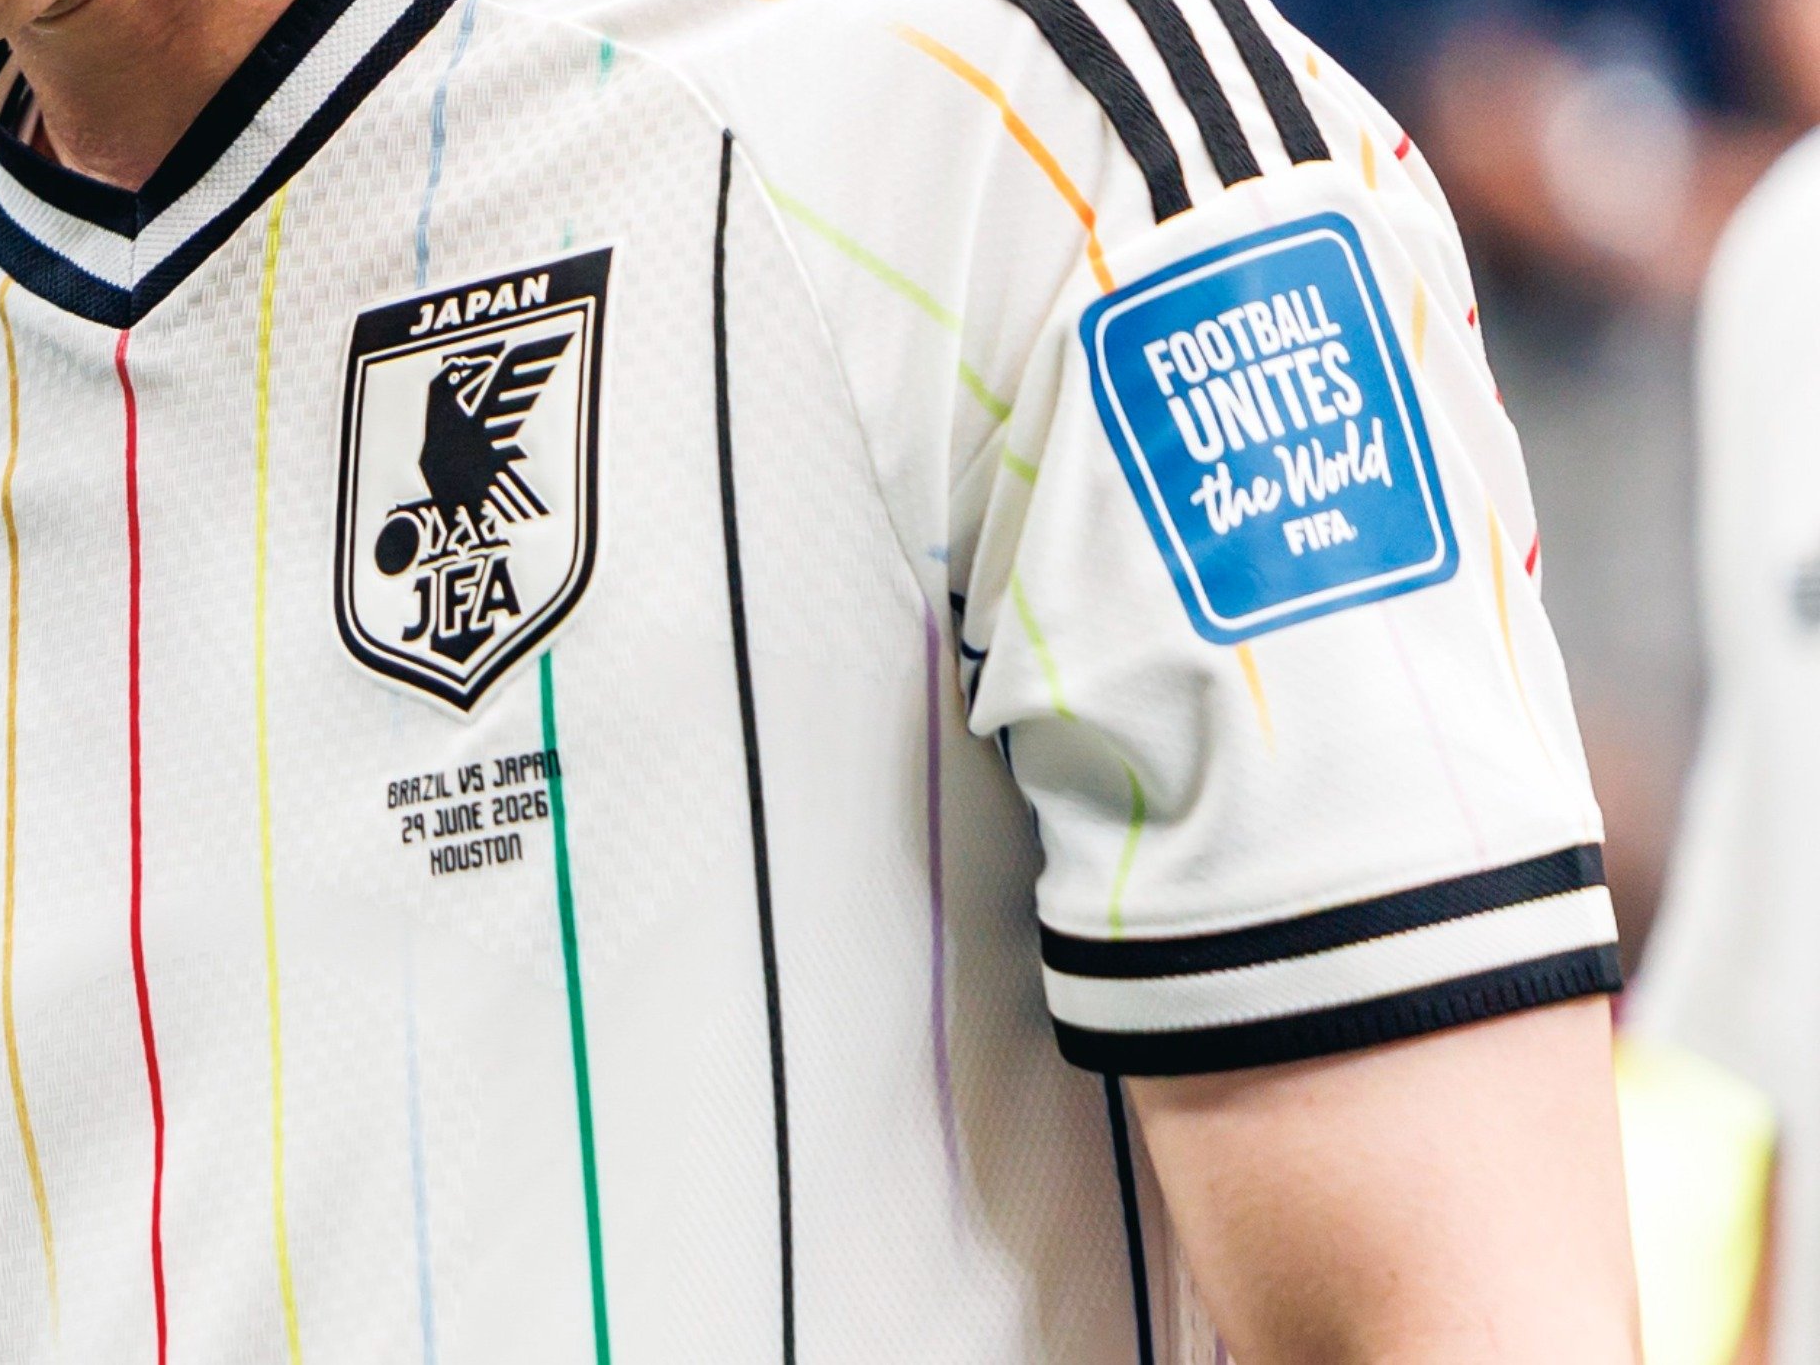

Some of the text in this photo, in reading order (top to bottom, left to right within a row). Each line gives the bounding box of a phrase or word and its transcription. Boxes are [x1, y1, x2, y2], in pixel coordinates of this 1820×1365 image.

[411, 273, 550, 335] JAPAN
[1143, 285, 1342, 397] FOOTBALL
[1167, 340, 1363, 462] UNITES
[1189, 417, 1393, 535] the World
[1282, 509, 1358, 556] FIFA
[402, 556, 521, 642] JFA
[387, 749, 561, 809] BRAZIL VS JAPAN
[401, 790, 549, 844] 29 JUNE 2026
[430, 833, 523, 876] HOUSTON
